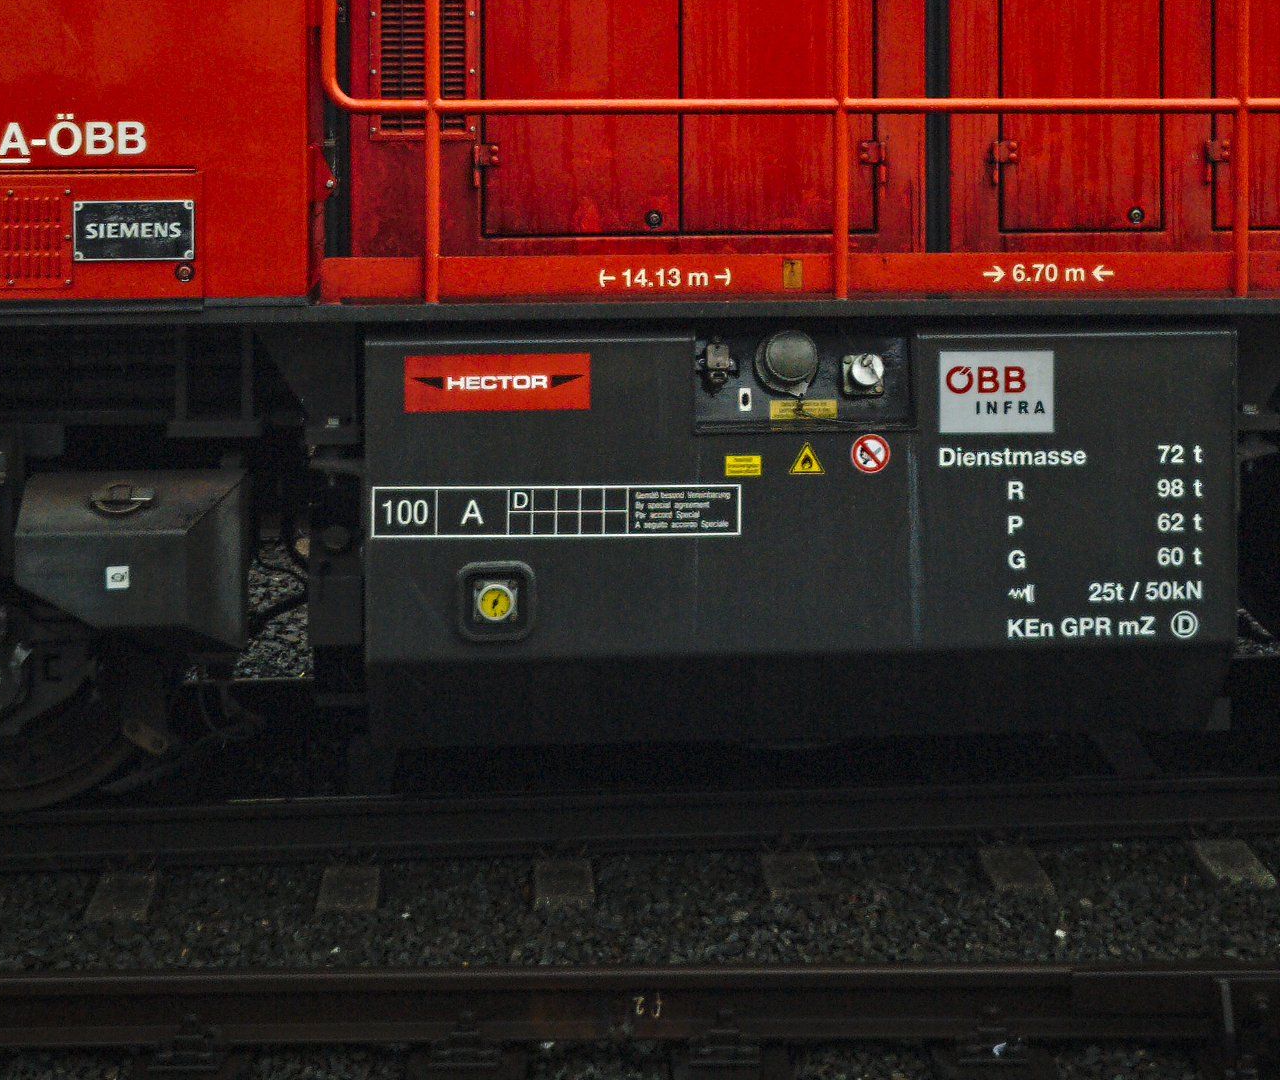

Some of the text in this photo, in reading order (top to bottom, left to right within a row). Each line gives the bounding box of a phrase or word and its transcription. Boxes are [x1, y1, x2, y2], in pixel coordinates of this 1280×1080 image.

[85, 222, 182, 240] SIEMENS
[622, 268, 709, 288] 14.13 m
[1013, 263, 1085, 283] 6.70 m
[446, 374, 549, 391] HECTOR
[945, 365, 1027, 395] ÖBB
[975, 399, 1046, 415] INFRA
[938, 445, 1203, 467] Dienstmasse 72 t
[1007, 478, 1203, 500] R 98 t
[382, 491, 529, 525] 100 A D
[1007, 512, 1203, 535] P 62 t
[1007, 546, 1203, 570] G 60 t
[1088, 582, 1125, 602] 25t
[1145, 580, 1203, 601] 50kN
[1007, 618, 1054, 638] KEn
[1060, 616, 1112, 637] GPR
[1118, 615, 1156, 636] mZ
